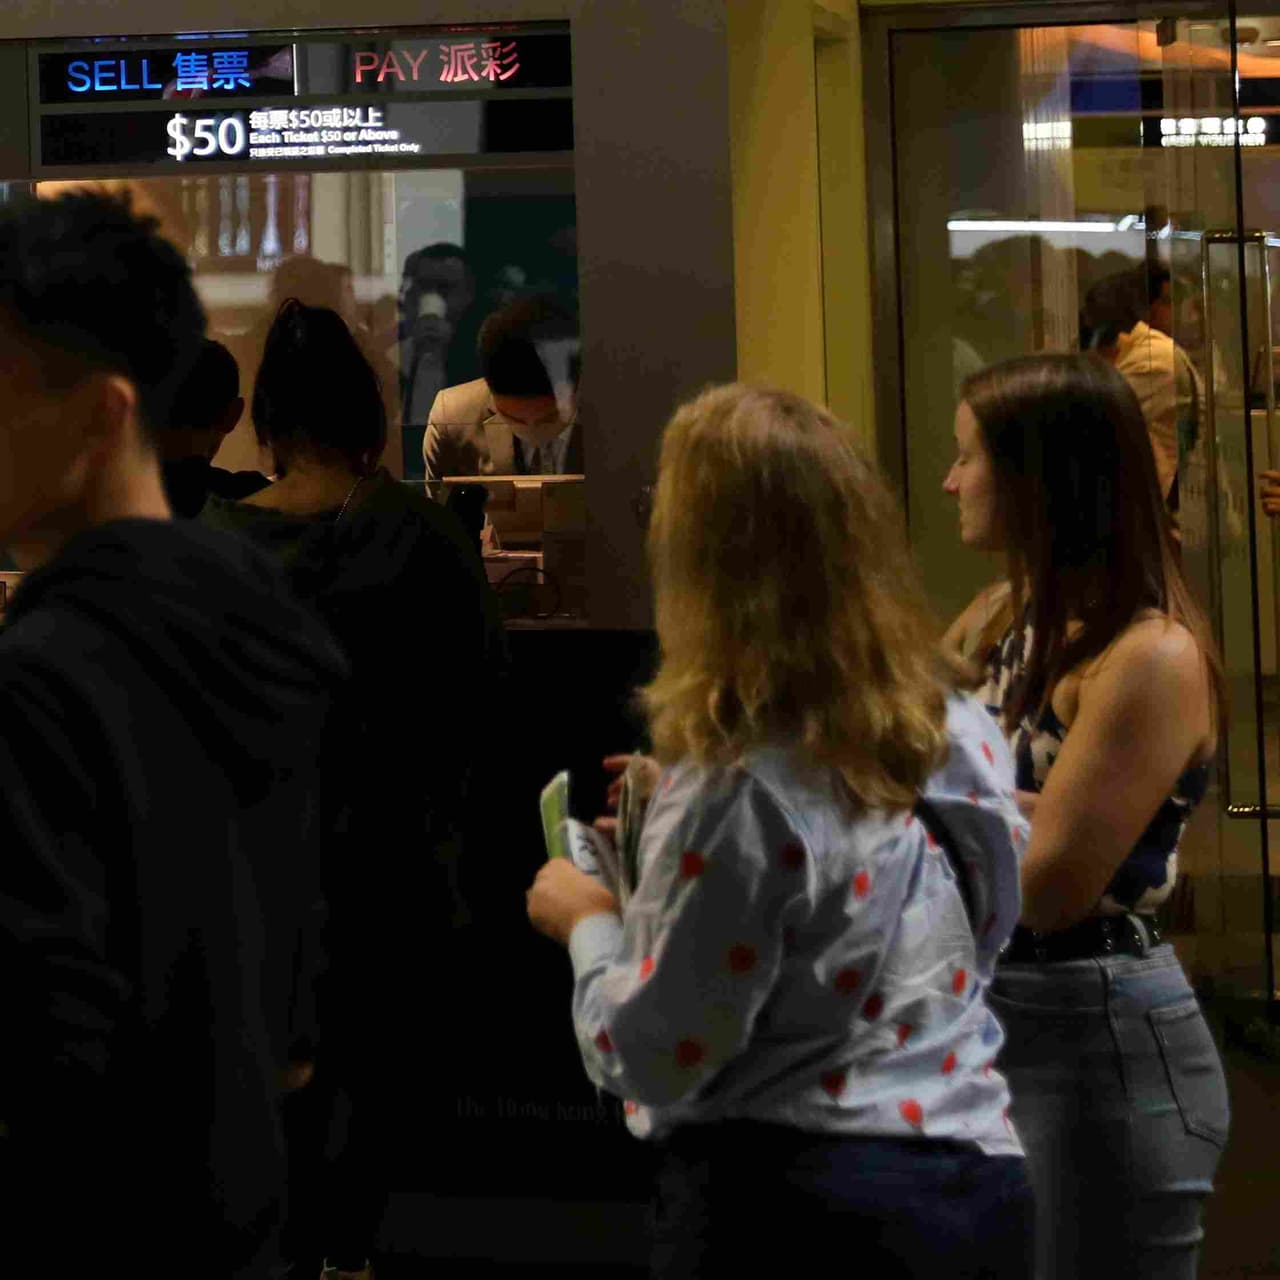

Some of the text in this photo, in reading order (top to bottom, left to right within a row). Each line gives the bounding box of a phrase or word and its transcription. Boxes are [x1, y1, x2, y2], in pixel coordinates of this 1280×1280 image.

[68, 51, 251, 92] SELL 售票
[355, 43, 519, 83] PAY 派彩
[167, 113, 245, 161] $50
